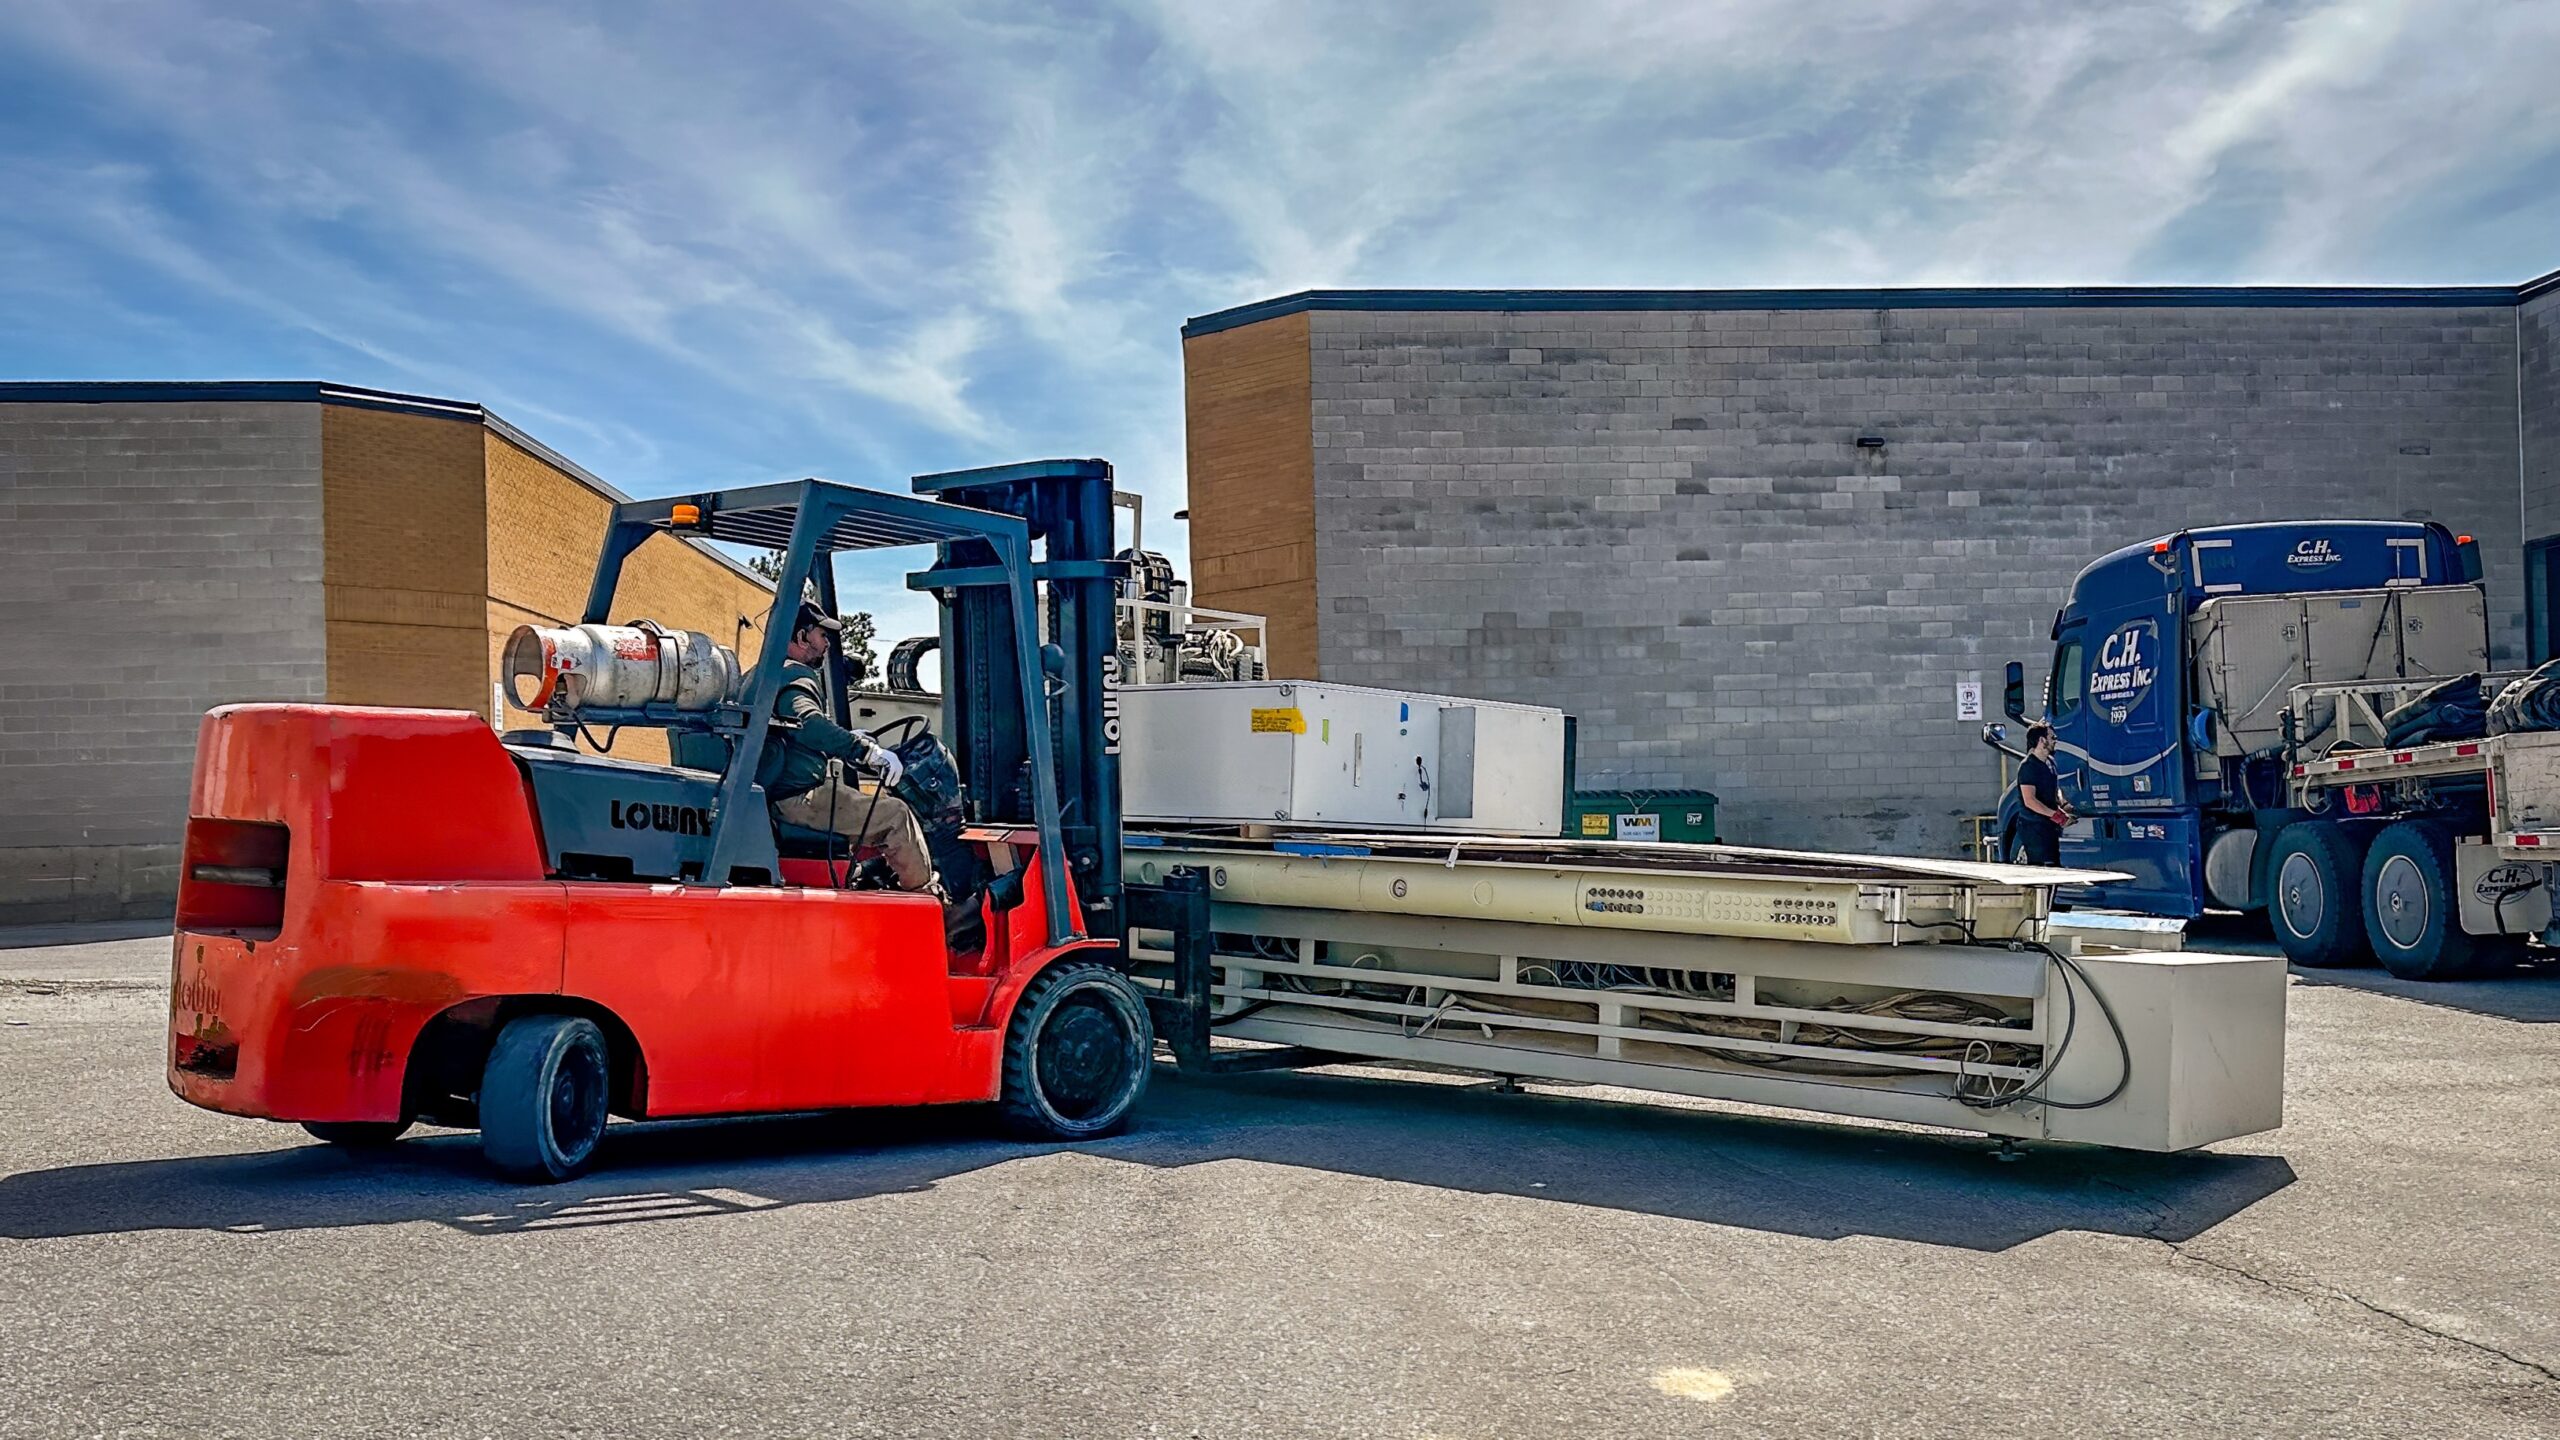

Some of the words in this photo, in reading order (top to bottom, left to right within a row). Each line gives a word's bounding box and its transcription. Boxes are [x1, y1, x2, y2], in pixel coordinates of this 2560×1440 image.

[2297, 540, 2332, 554] C.H.
[2101, 629, 2141, 670] C.H.
[2089, 672, 2131, 694] EXPRESS
[2132, 665, 2152, 688] INC.
[1623, 817, 1652, 827] WM
[2487, 868, 2521, 883] C.H.
